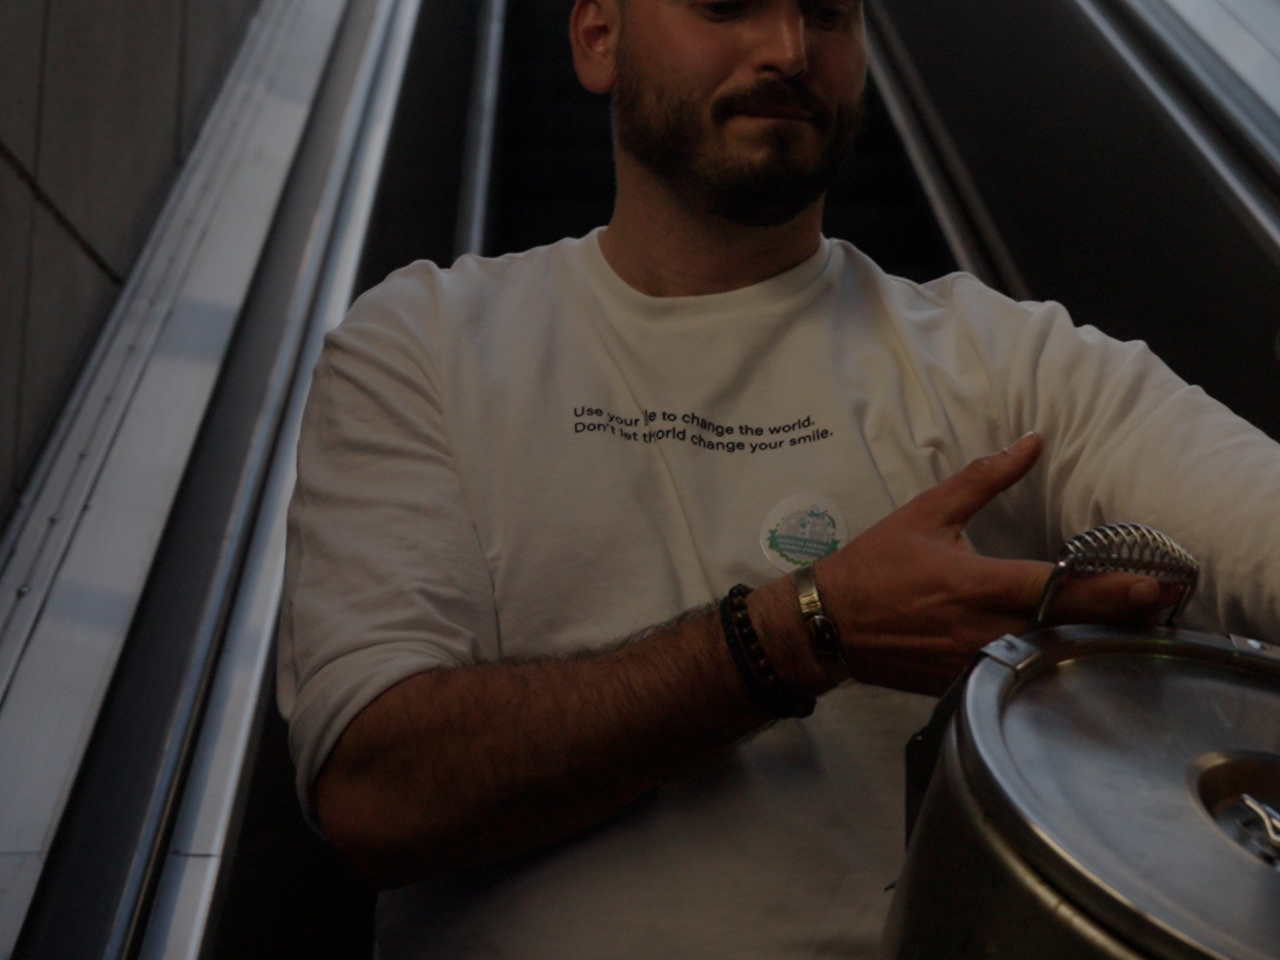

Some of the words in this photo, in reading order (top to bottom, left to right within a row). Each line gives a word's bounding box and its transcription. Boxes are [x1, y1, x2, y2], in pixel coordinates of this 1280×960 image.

[573, 406, 604, 418] Use
[606, 412, 640, 427] your
[661, 411, 677, 422] to
[681, 412, 735, 437] change
[738, 424, 764, 436] the
[768, 415, 816, 435] world.
[574, 422, 616, 435] Don't
[619, 428, 639, 442] let
[655, 427, 687, 441] orld
[690, 434, 746, 453] change
[749, 439, 785, 454] your
[788, 428, 834, 447] smile.
